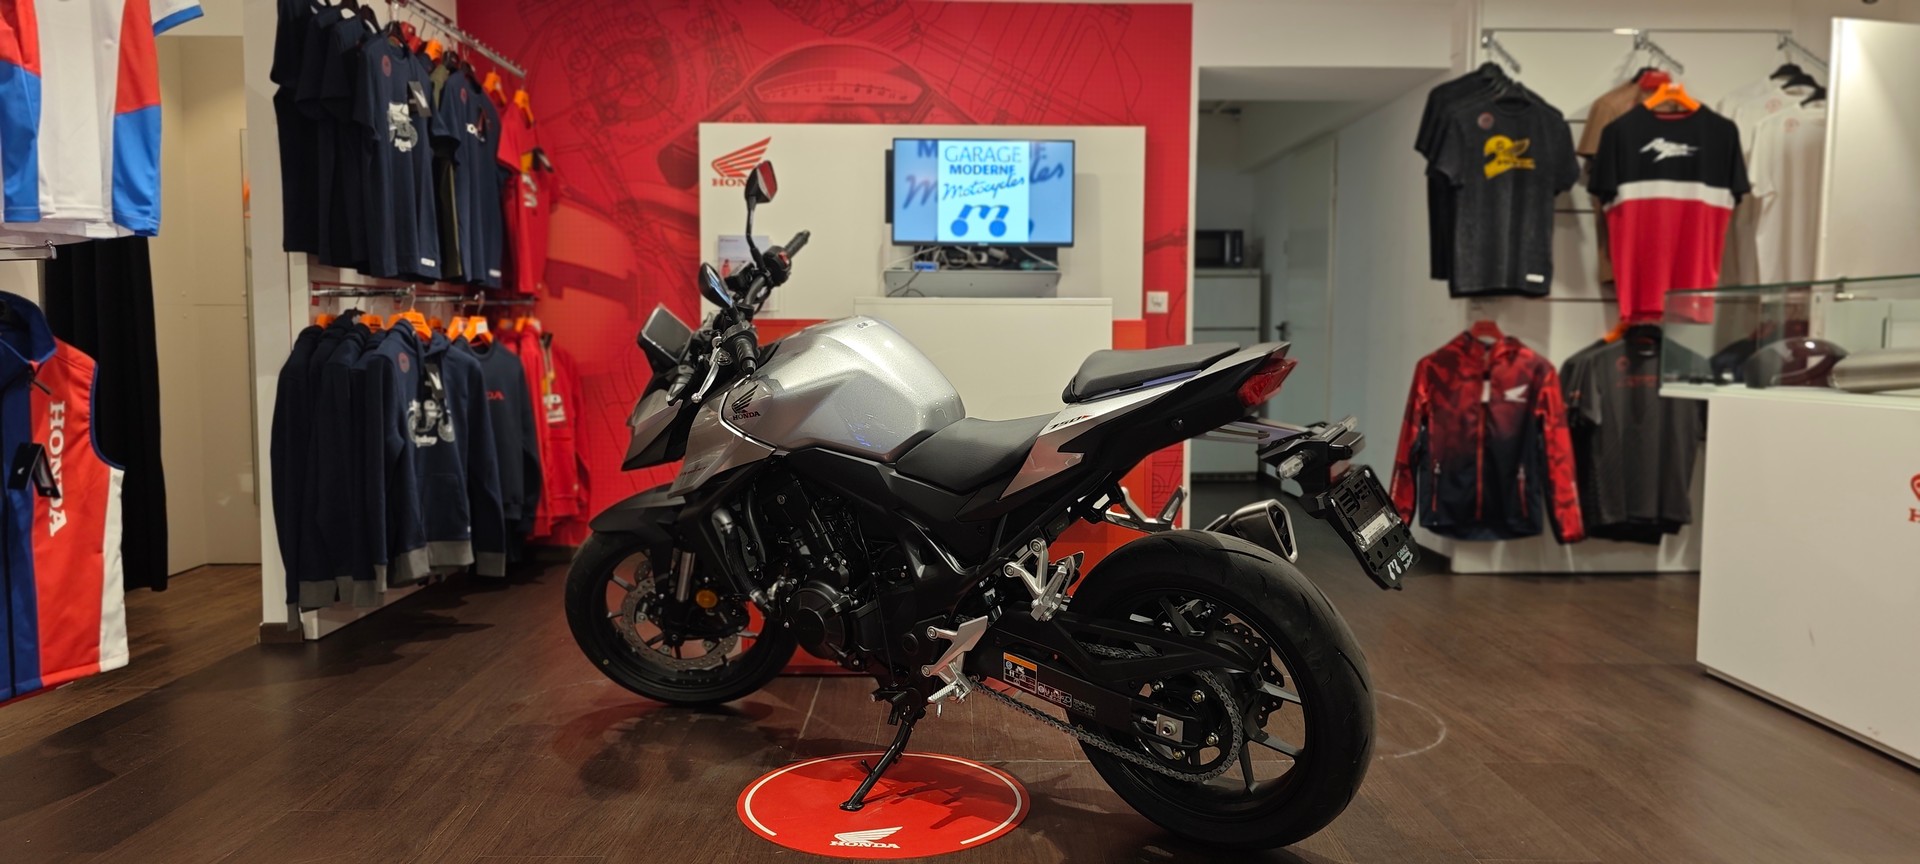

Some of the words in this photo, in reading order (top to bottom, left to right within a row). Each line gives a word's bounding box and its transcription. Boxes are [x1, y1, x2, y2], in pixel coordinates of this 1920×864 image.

[945, 145, 1021, 163] GARAGE
[949, 164, 1016, 175] MODERNE
[712, 178, 747, 187] HON
[943, 172, 1024, 201] Motocycles
[732, 411, 761, 421] HONDA
[829, 840, 901, 849] HONDA
